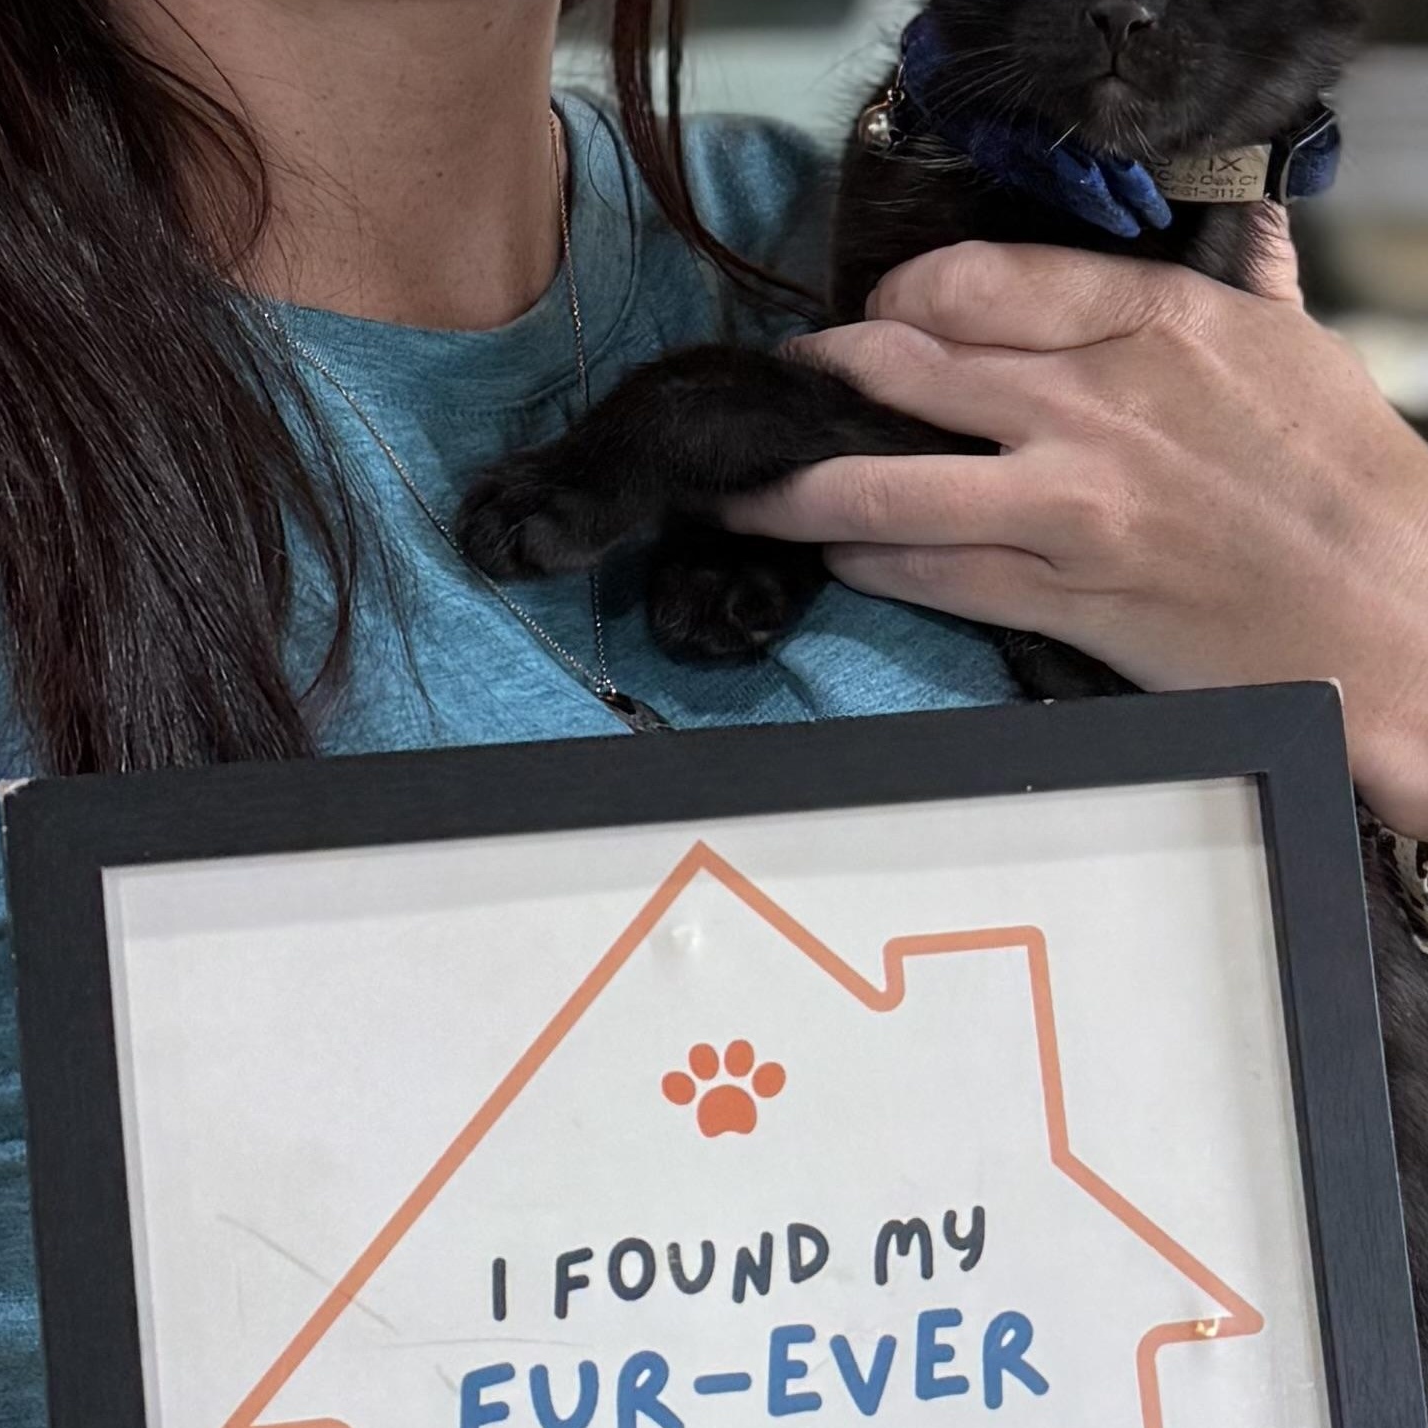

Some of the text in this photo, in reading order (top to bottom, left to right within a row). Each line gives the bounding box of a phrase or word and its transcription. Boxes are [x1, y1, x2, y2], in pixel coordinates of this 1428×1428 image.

[491, 1204, 986, 1323] I FOUND MY
